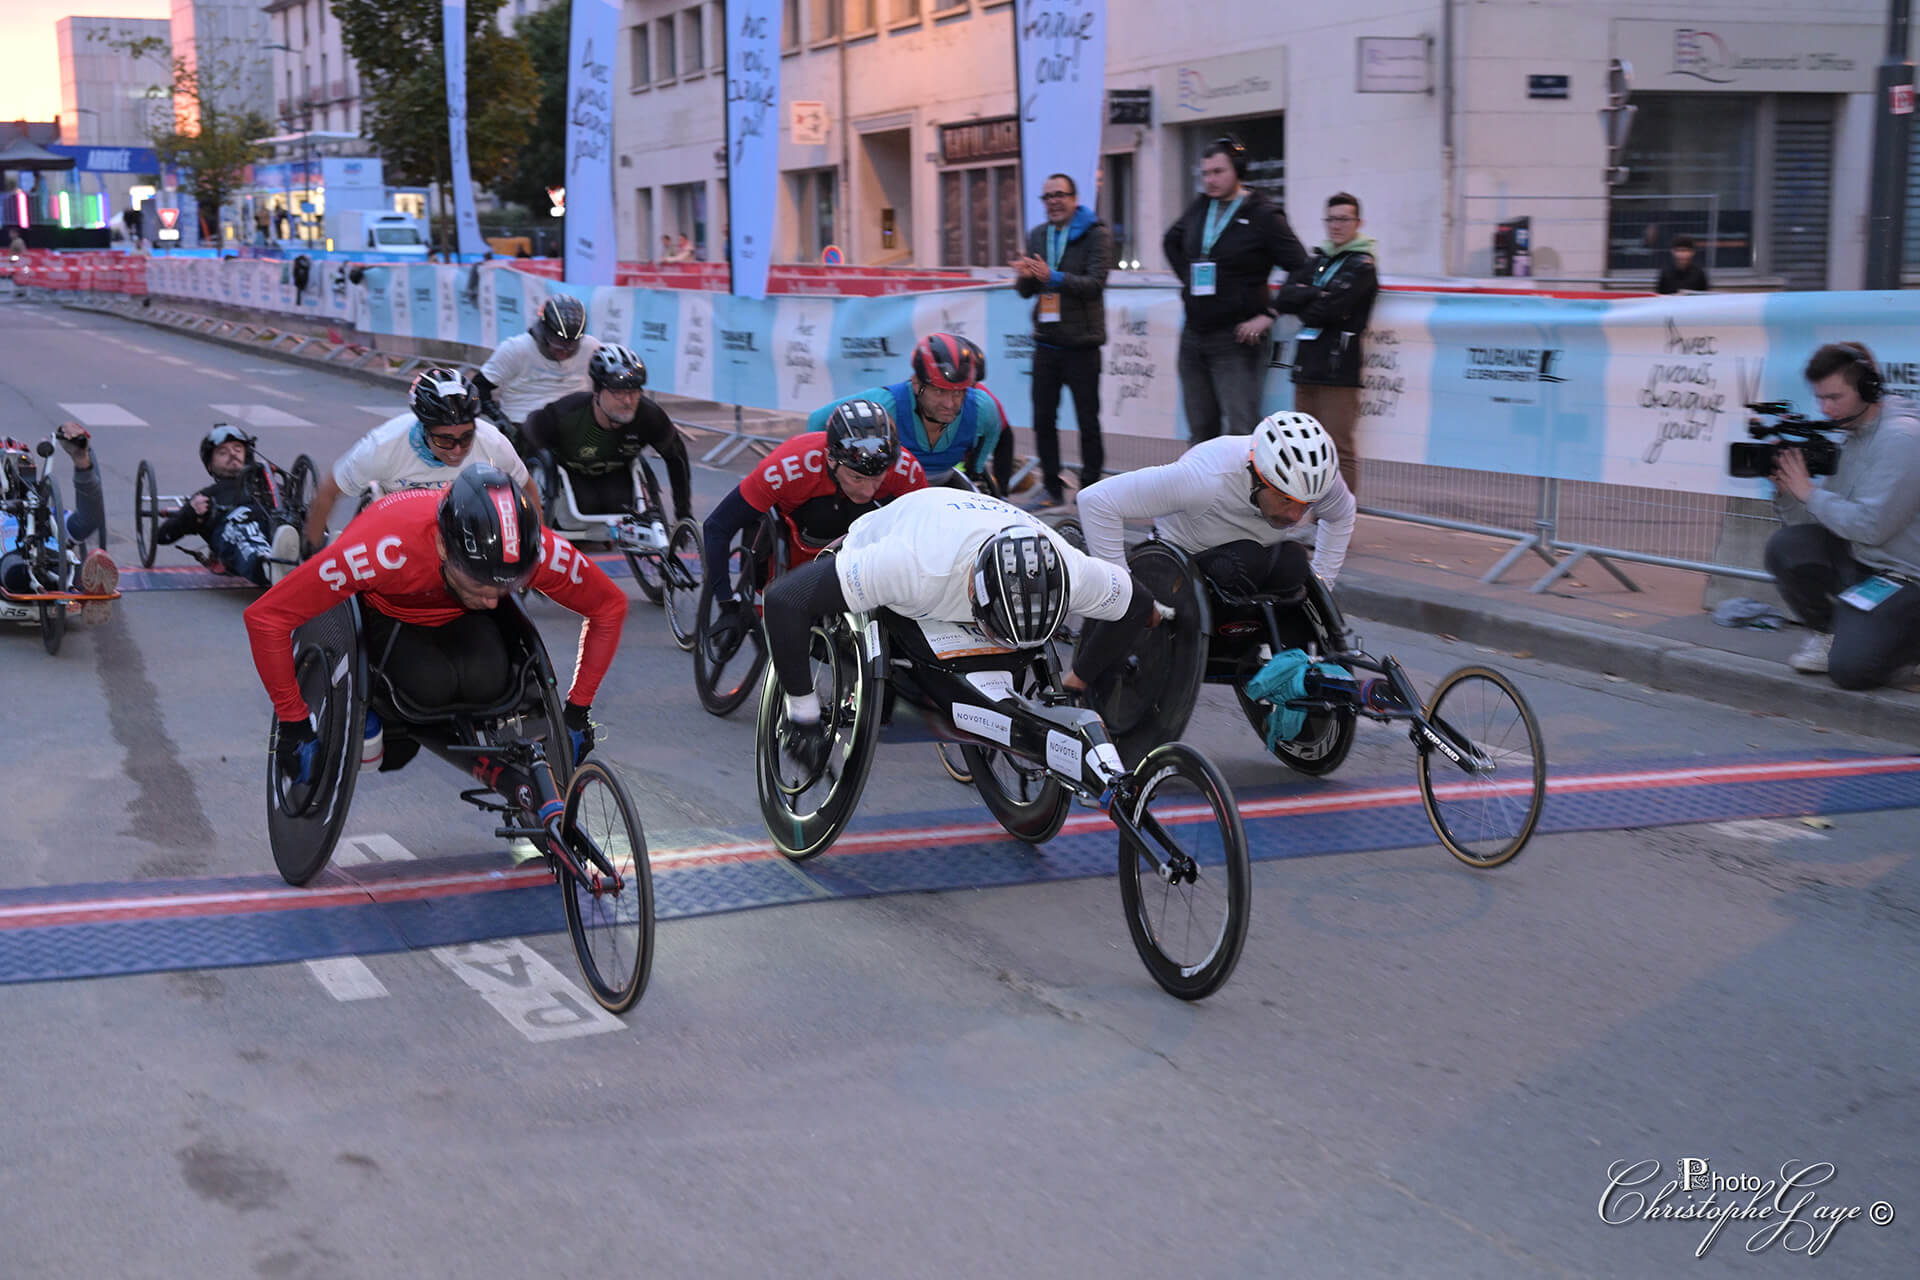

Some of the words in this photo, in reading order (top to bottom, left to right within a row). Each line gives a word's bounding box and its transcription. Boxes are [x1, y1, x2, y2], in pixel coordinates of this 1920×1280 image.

[764, 450, 823, 490] SEC
[497, 493, 519, 557] AERO
[318, 535, 408, 591] SEC
[957, 712, 991, 727] NOVOTEL
[1050, 741, 1080, 761] NOVOTEL
[1423, 727, 1442, 745] TOP
[1440, 743, 1461, 763] END
